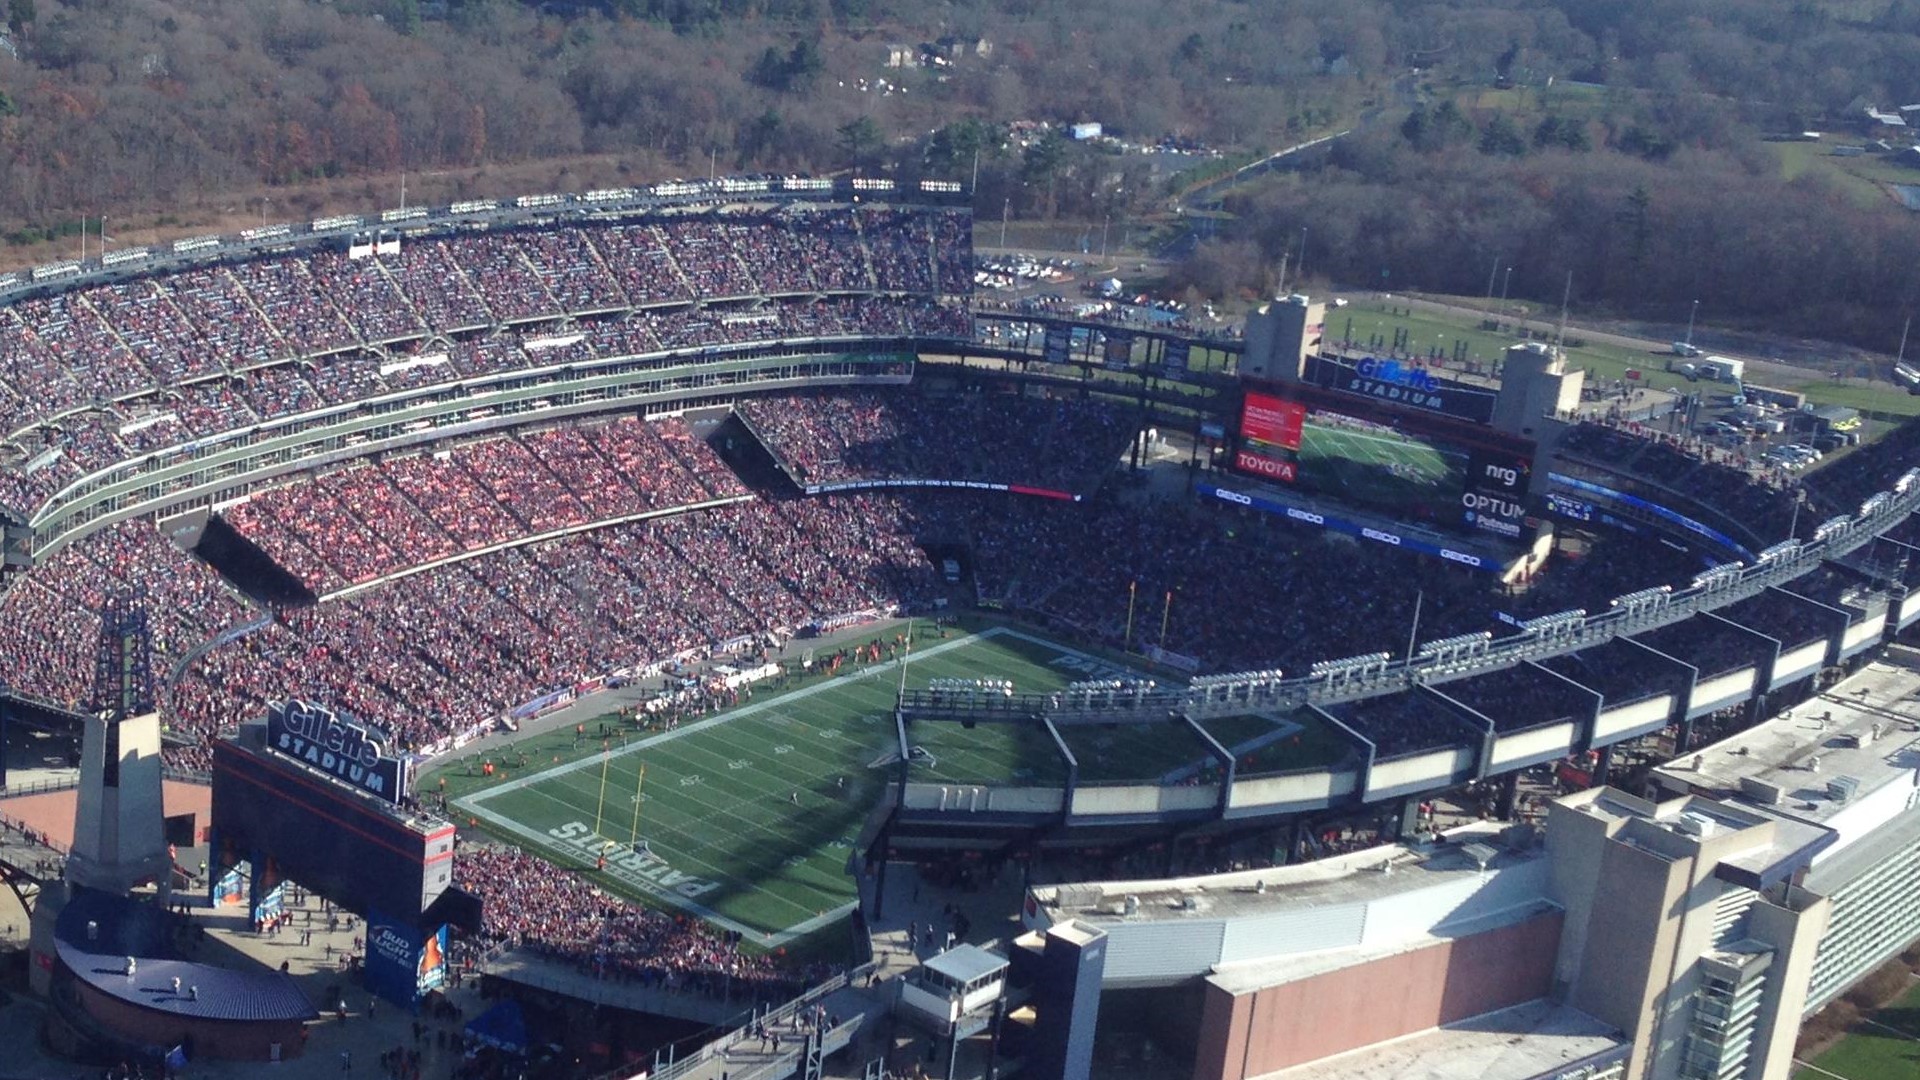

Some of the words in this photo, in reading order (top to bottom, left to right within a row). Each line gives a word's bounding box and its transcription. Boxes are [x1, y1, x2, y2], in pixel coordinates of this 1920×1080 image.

[1355, 356, 1440, 393] Gillette
[1350, 379, 1442, 408] STADIUM
[1239, 454, 1292, 477] TOYOTA
[1486, 465, 1517, 486] nrg
[1216, 488, 1251, 505] GEICO
[1287, 507, 1324, 524] GEICO
[1362, 527, 1400, 545] GEICO
[1440, 548, 1480, 566] GEICO
[283, 699, 381, 768] Gillette
[279, 733, 383, 792] STADIUM
[549, 821, 721, 898] PATRIOTS
[375, 936, 412, 959] LIGHT
[382, 929, 410, 949] BUD
